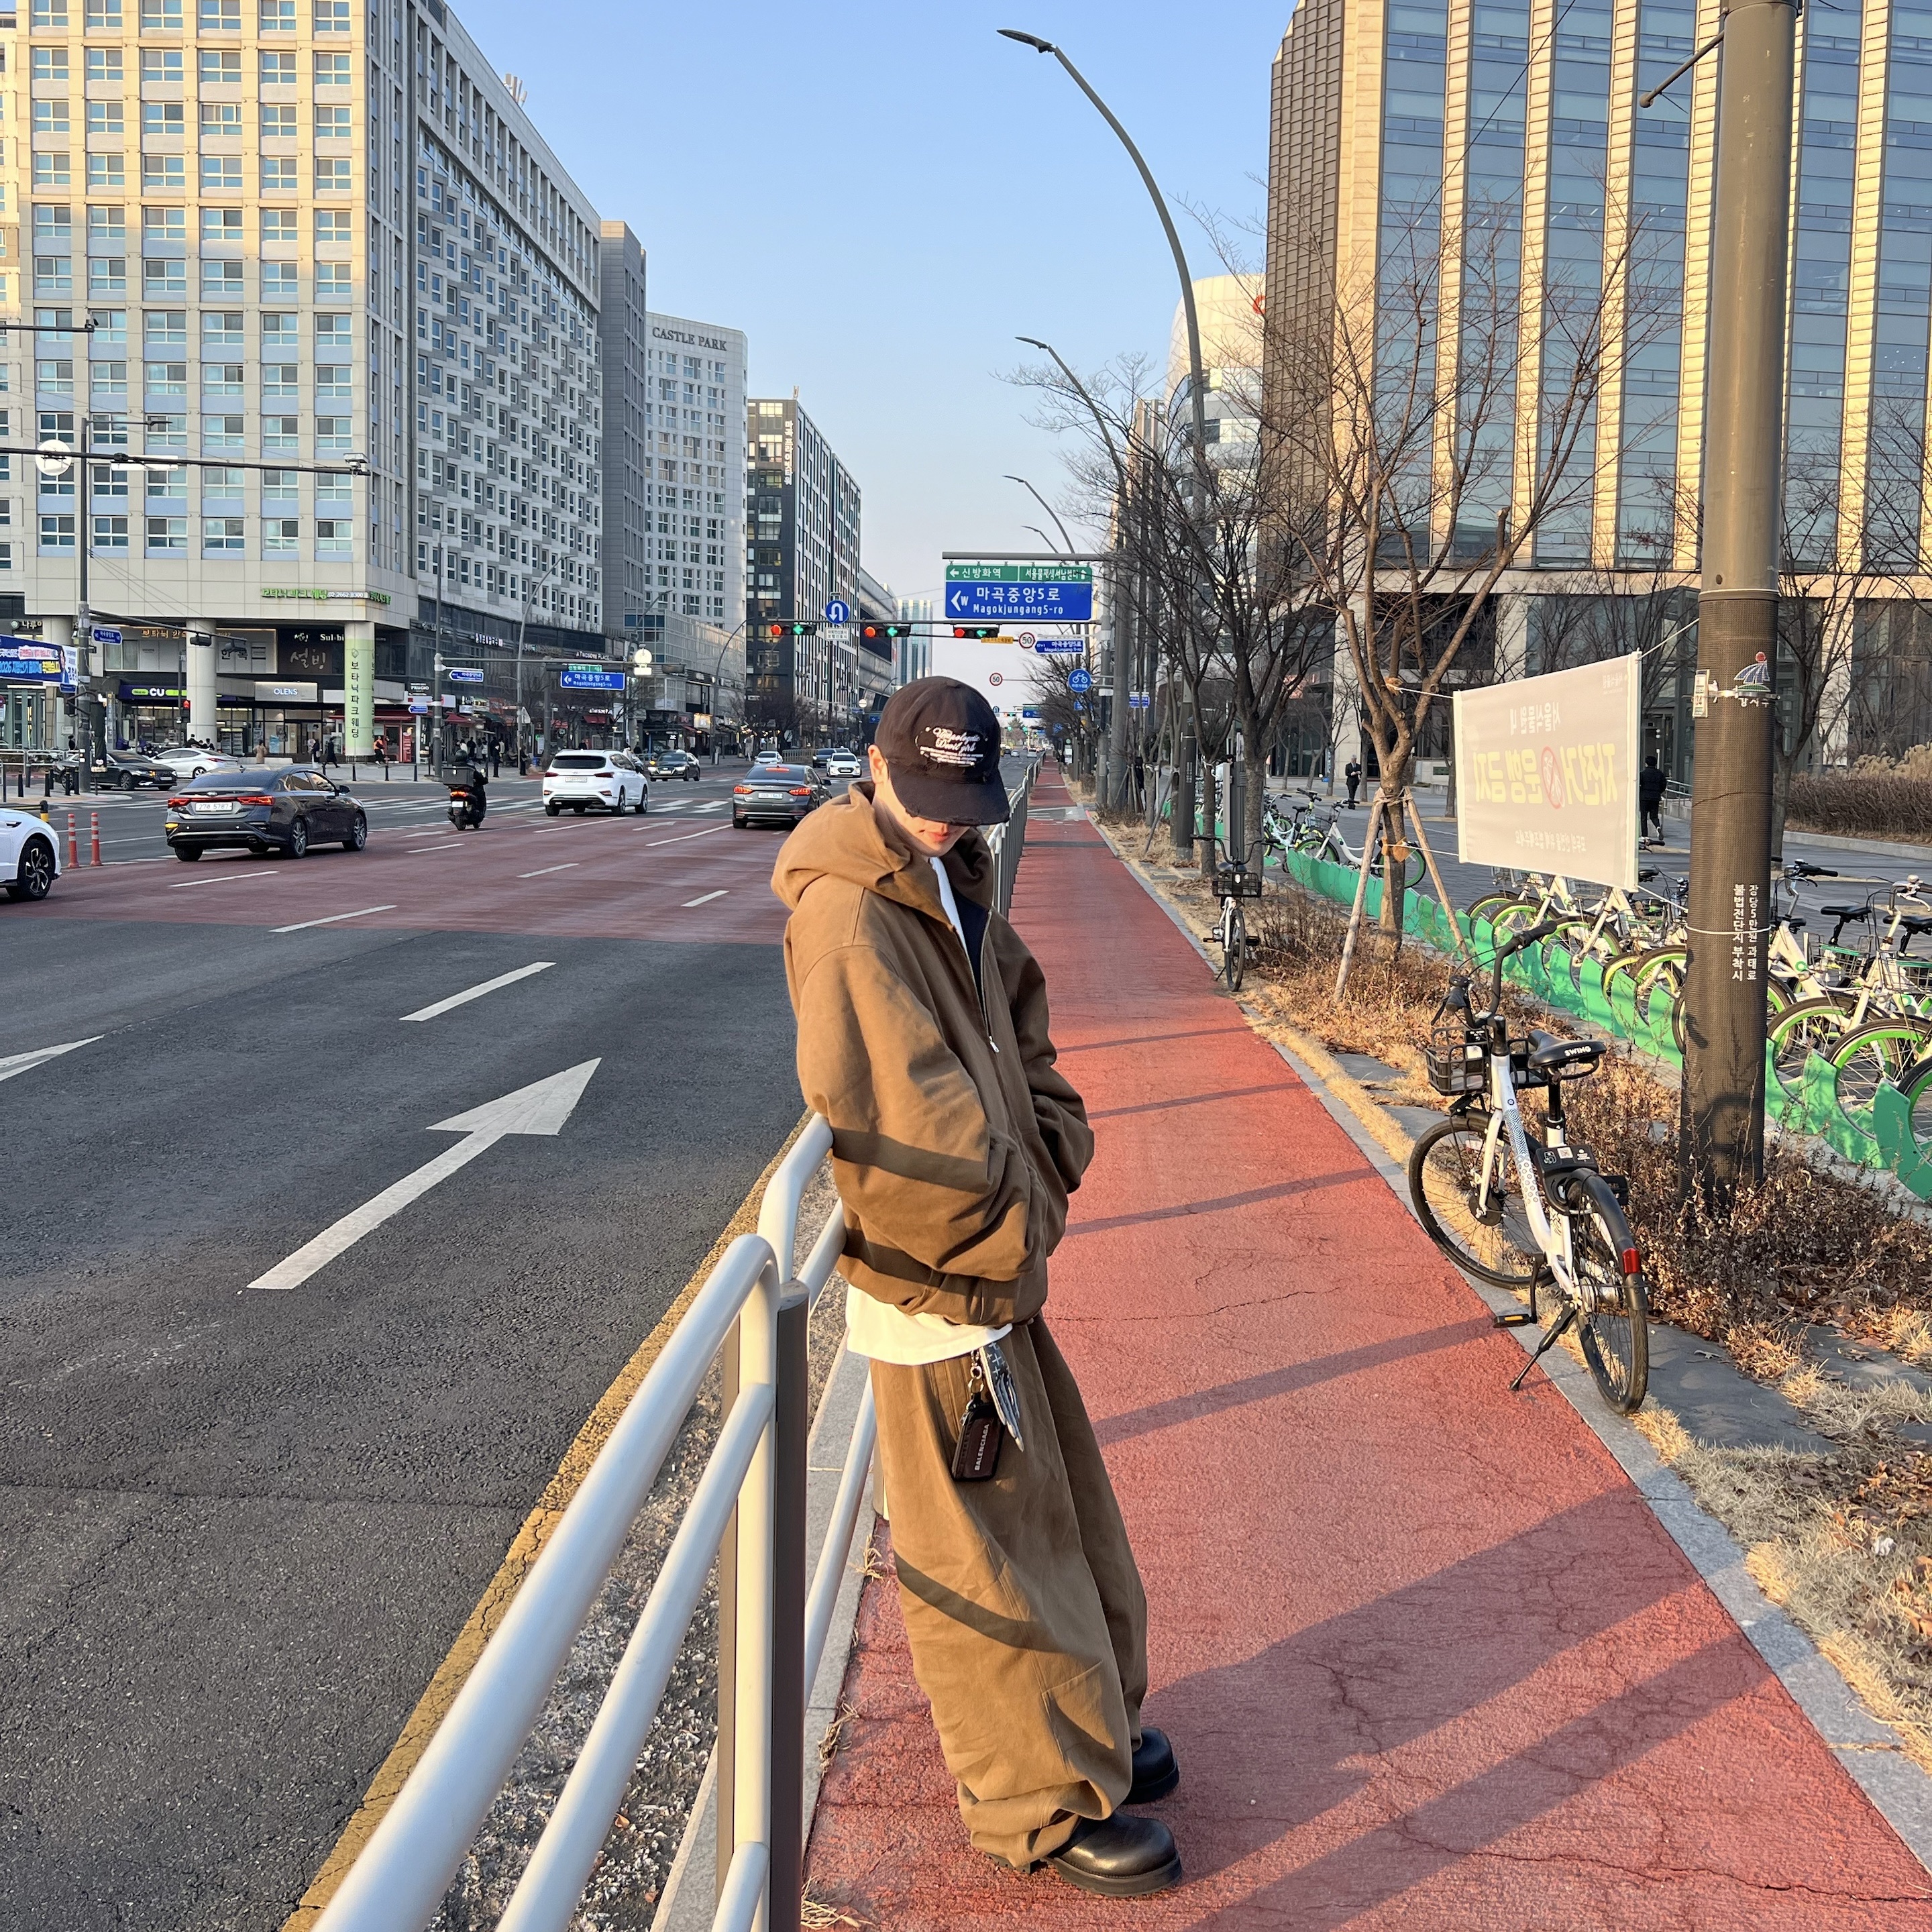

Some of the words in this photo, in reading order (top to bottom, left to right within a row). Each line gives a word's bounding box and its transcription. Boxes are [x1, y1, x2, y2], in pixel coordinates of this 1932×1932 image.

[652, 326, 695, 345] CASTLE
[698, 335, 727, 351] PARK
[961, 568, 1002, 579] 신방화역
[262, 588, 288, 598] 보타닉
[289, 588, 308, 598] 파크
[310, 588, 328, 600] 웨딩
[961, 596, 969, 606] W
[976, 586, 1061, 604] 마곡중앙5로
[973, 603, 1064, 616] Magokjungang5-ro
[290, 647, 326, 669] 설빙
[574, 673, 610, 682] 마곡중앙5로
[149, 688, 165, 697] CU
[351, 661, 360, 738] 보타닉파크웨딩
[1732, 883, 1746, 944] 불법전단지
[1748, 884, 1759, 943] 장당5만원
[1732, 946, 1744, 981] 부착시
[1747, 946, 1758, 980] 과태료
[1564, 1045, 1591, 1057] SWING
[974, 1424, 990, 1471] BALENCIAGA
